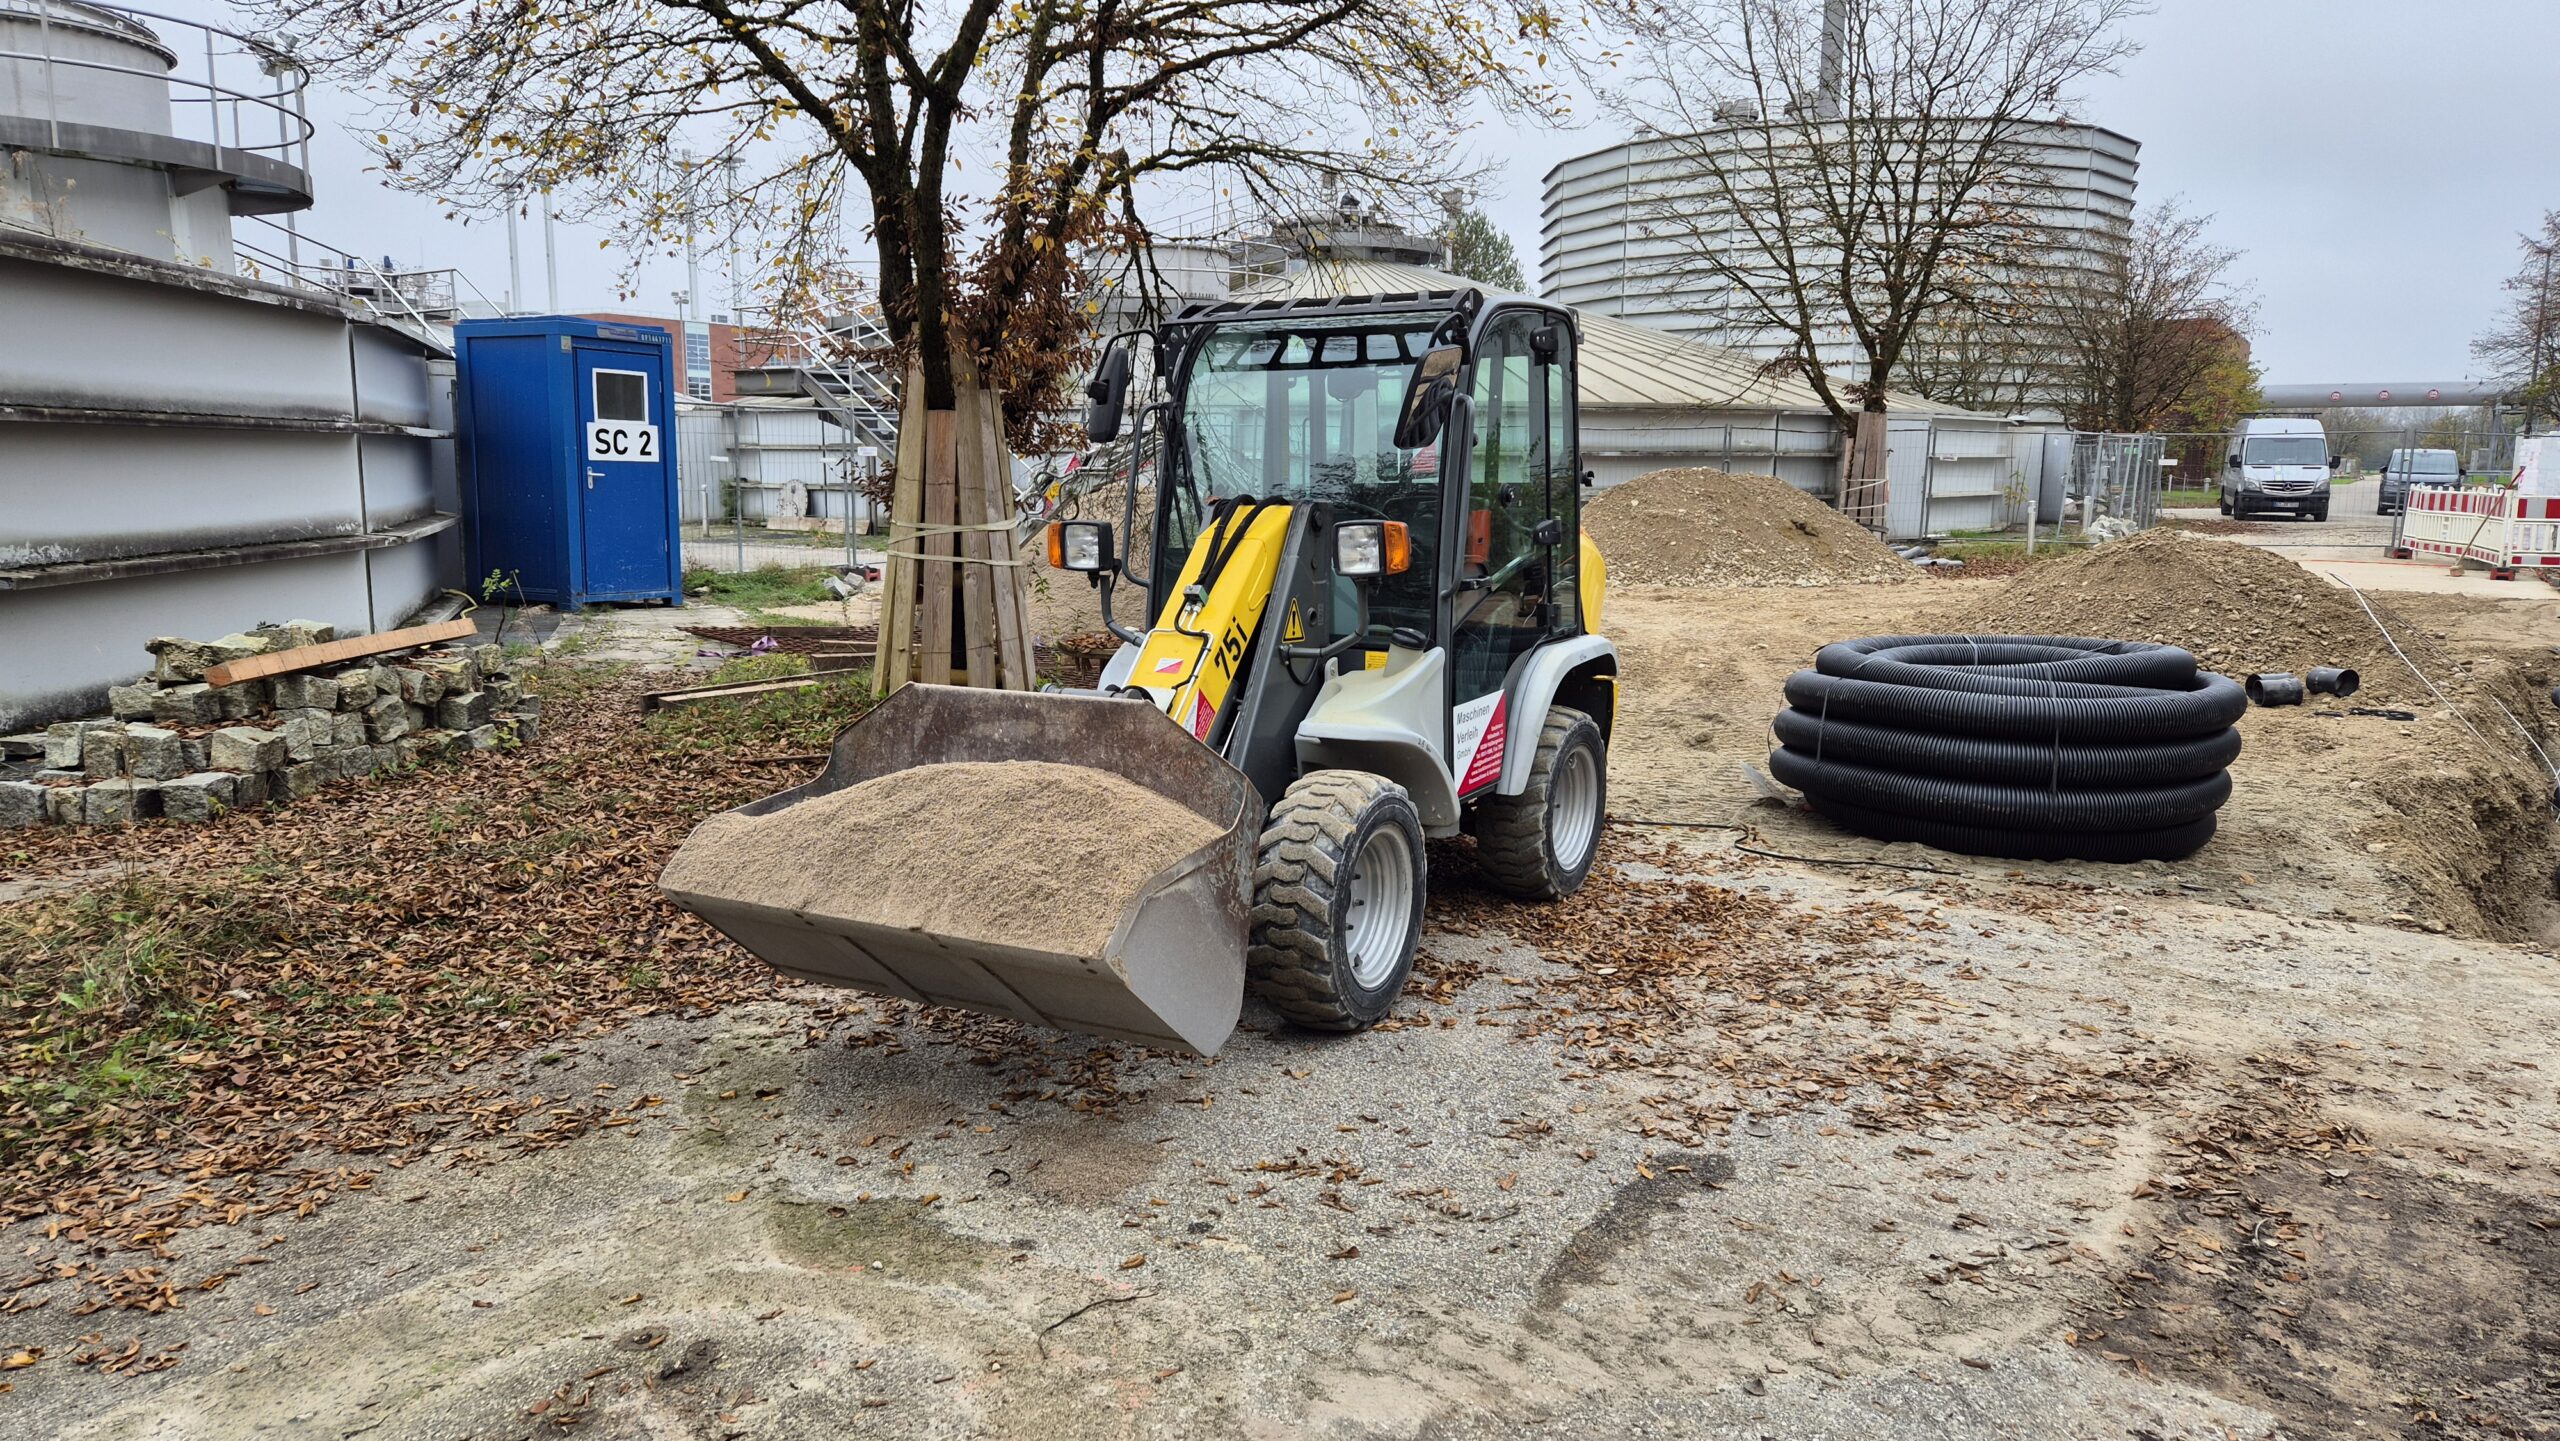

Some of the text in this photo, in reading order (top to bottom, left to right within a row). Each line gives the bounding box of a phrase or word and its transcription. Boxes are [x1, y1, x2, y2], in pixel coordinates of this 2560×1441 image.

[595, 428, 652, 456] SC 2
[1214, 616, 1247, 681] 75i
[1457, 704, 1490, 725] Maschinen
[1457, 725, 1479, 745] Verleih
[1456, 745, 1472, 760] GmbH
